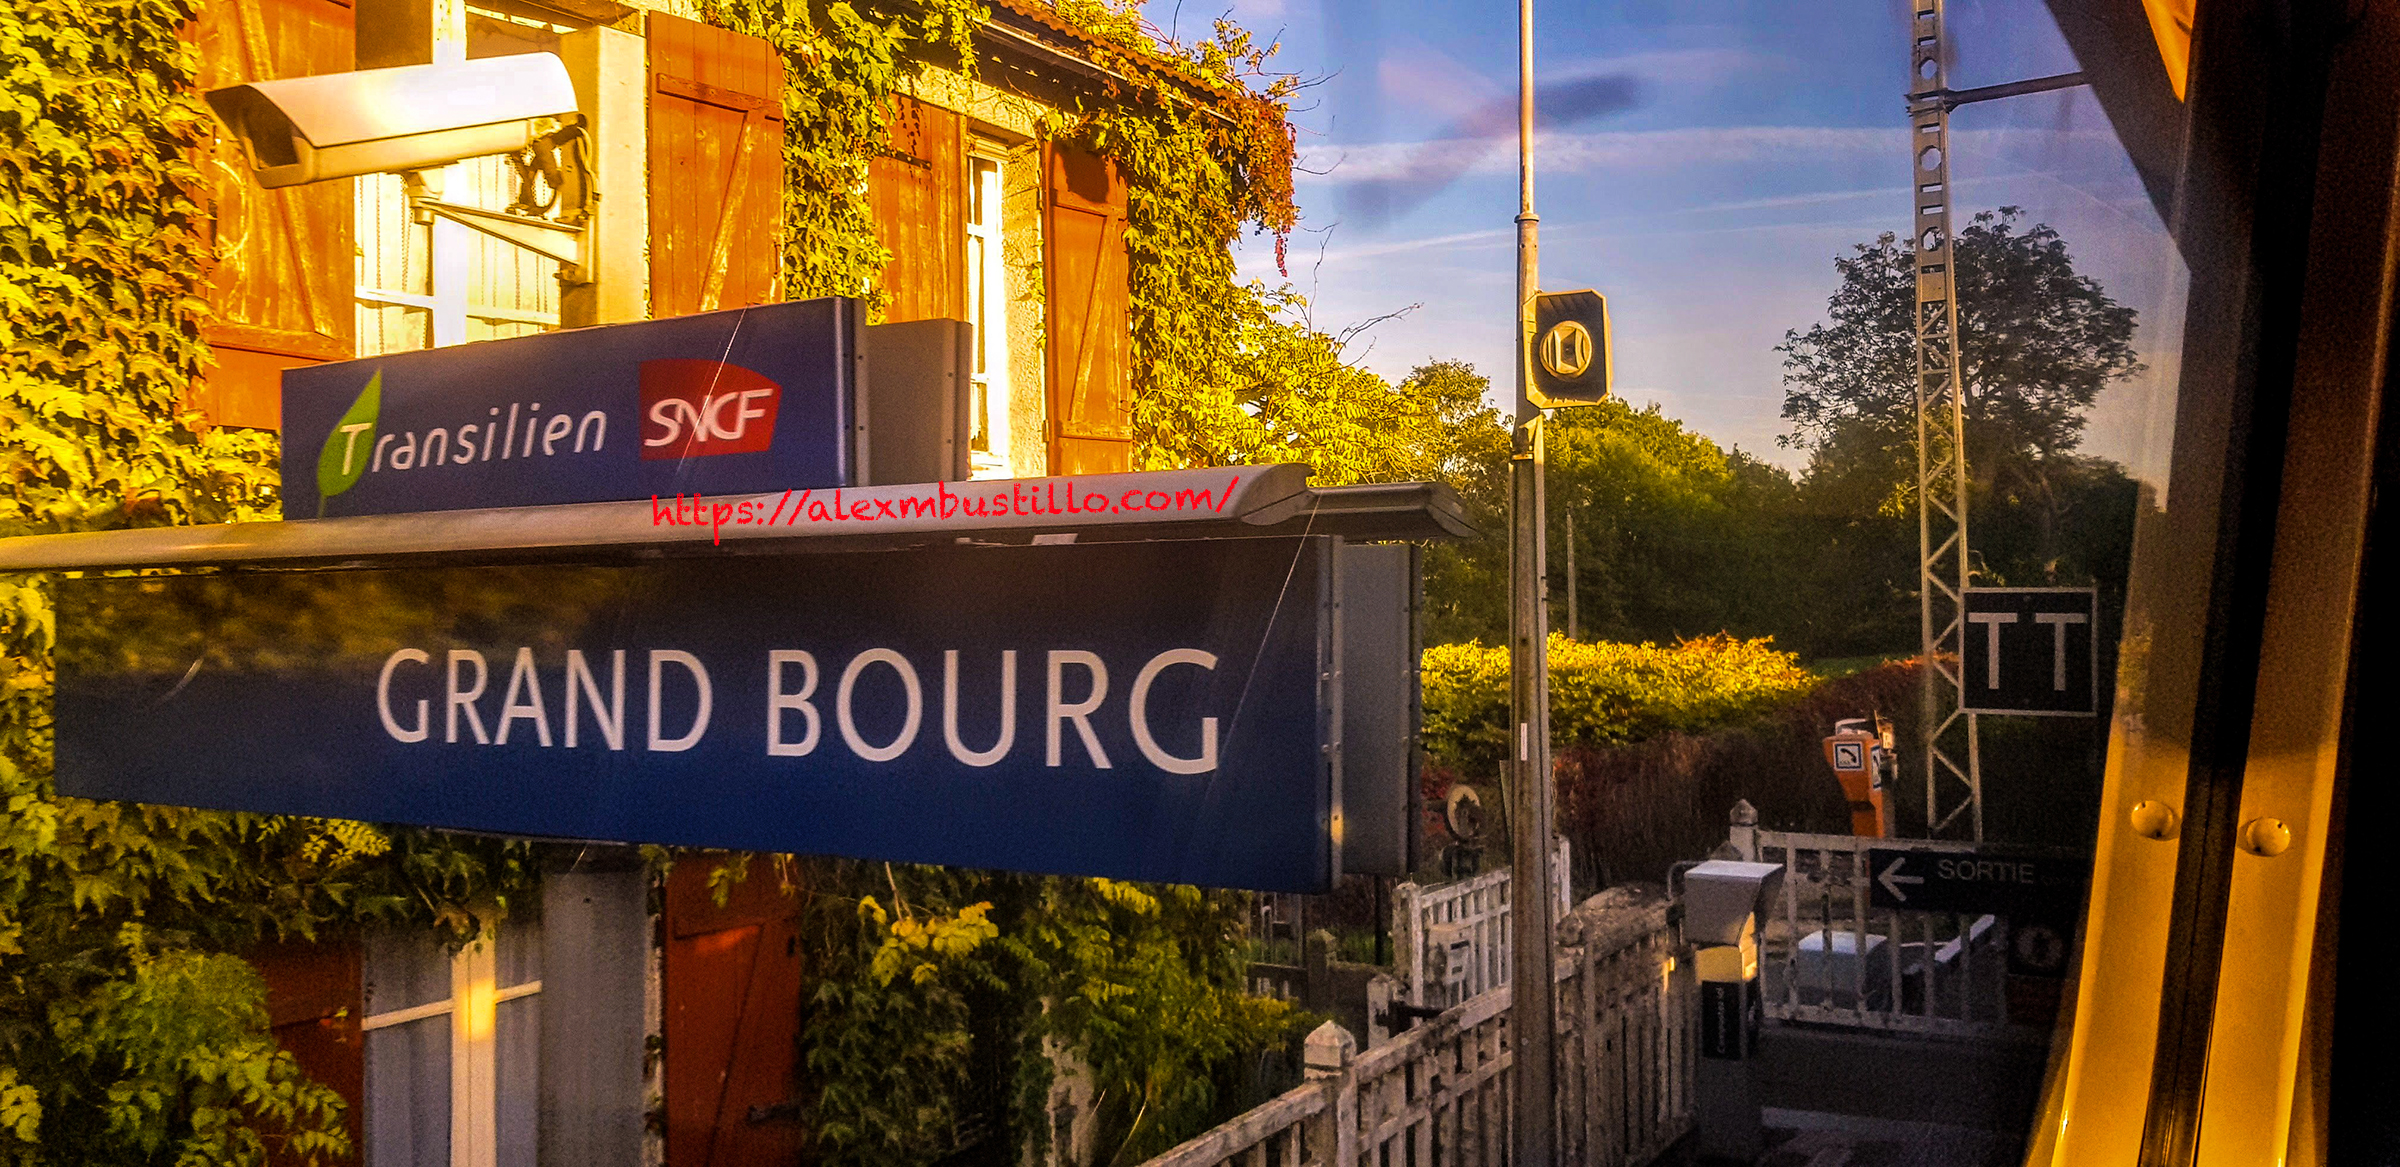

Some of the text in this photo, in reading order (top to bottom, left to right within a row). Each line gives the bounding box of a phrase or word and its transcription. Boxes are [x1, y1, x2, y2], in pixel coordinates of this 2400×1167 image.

[340, 388, 774, 475] Transilien SNCF
[1968, 612, 2088, 690] TT
[375, 647, 1219, 775] GRAND BOURG
[1937, 858, 2035, 885] SORTIE
